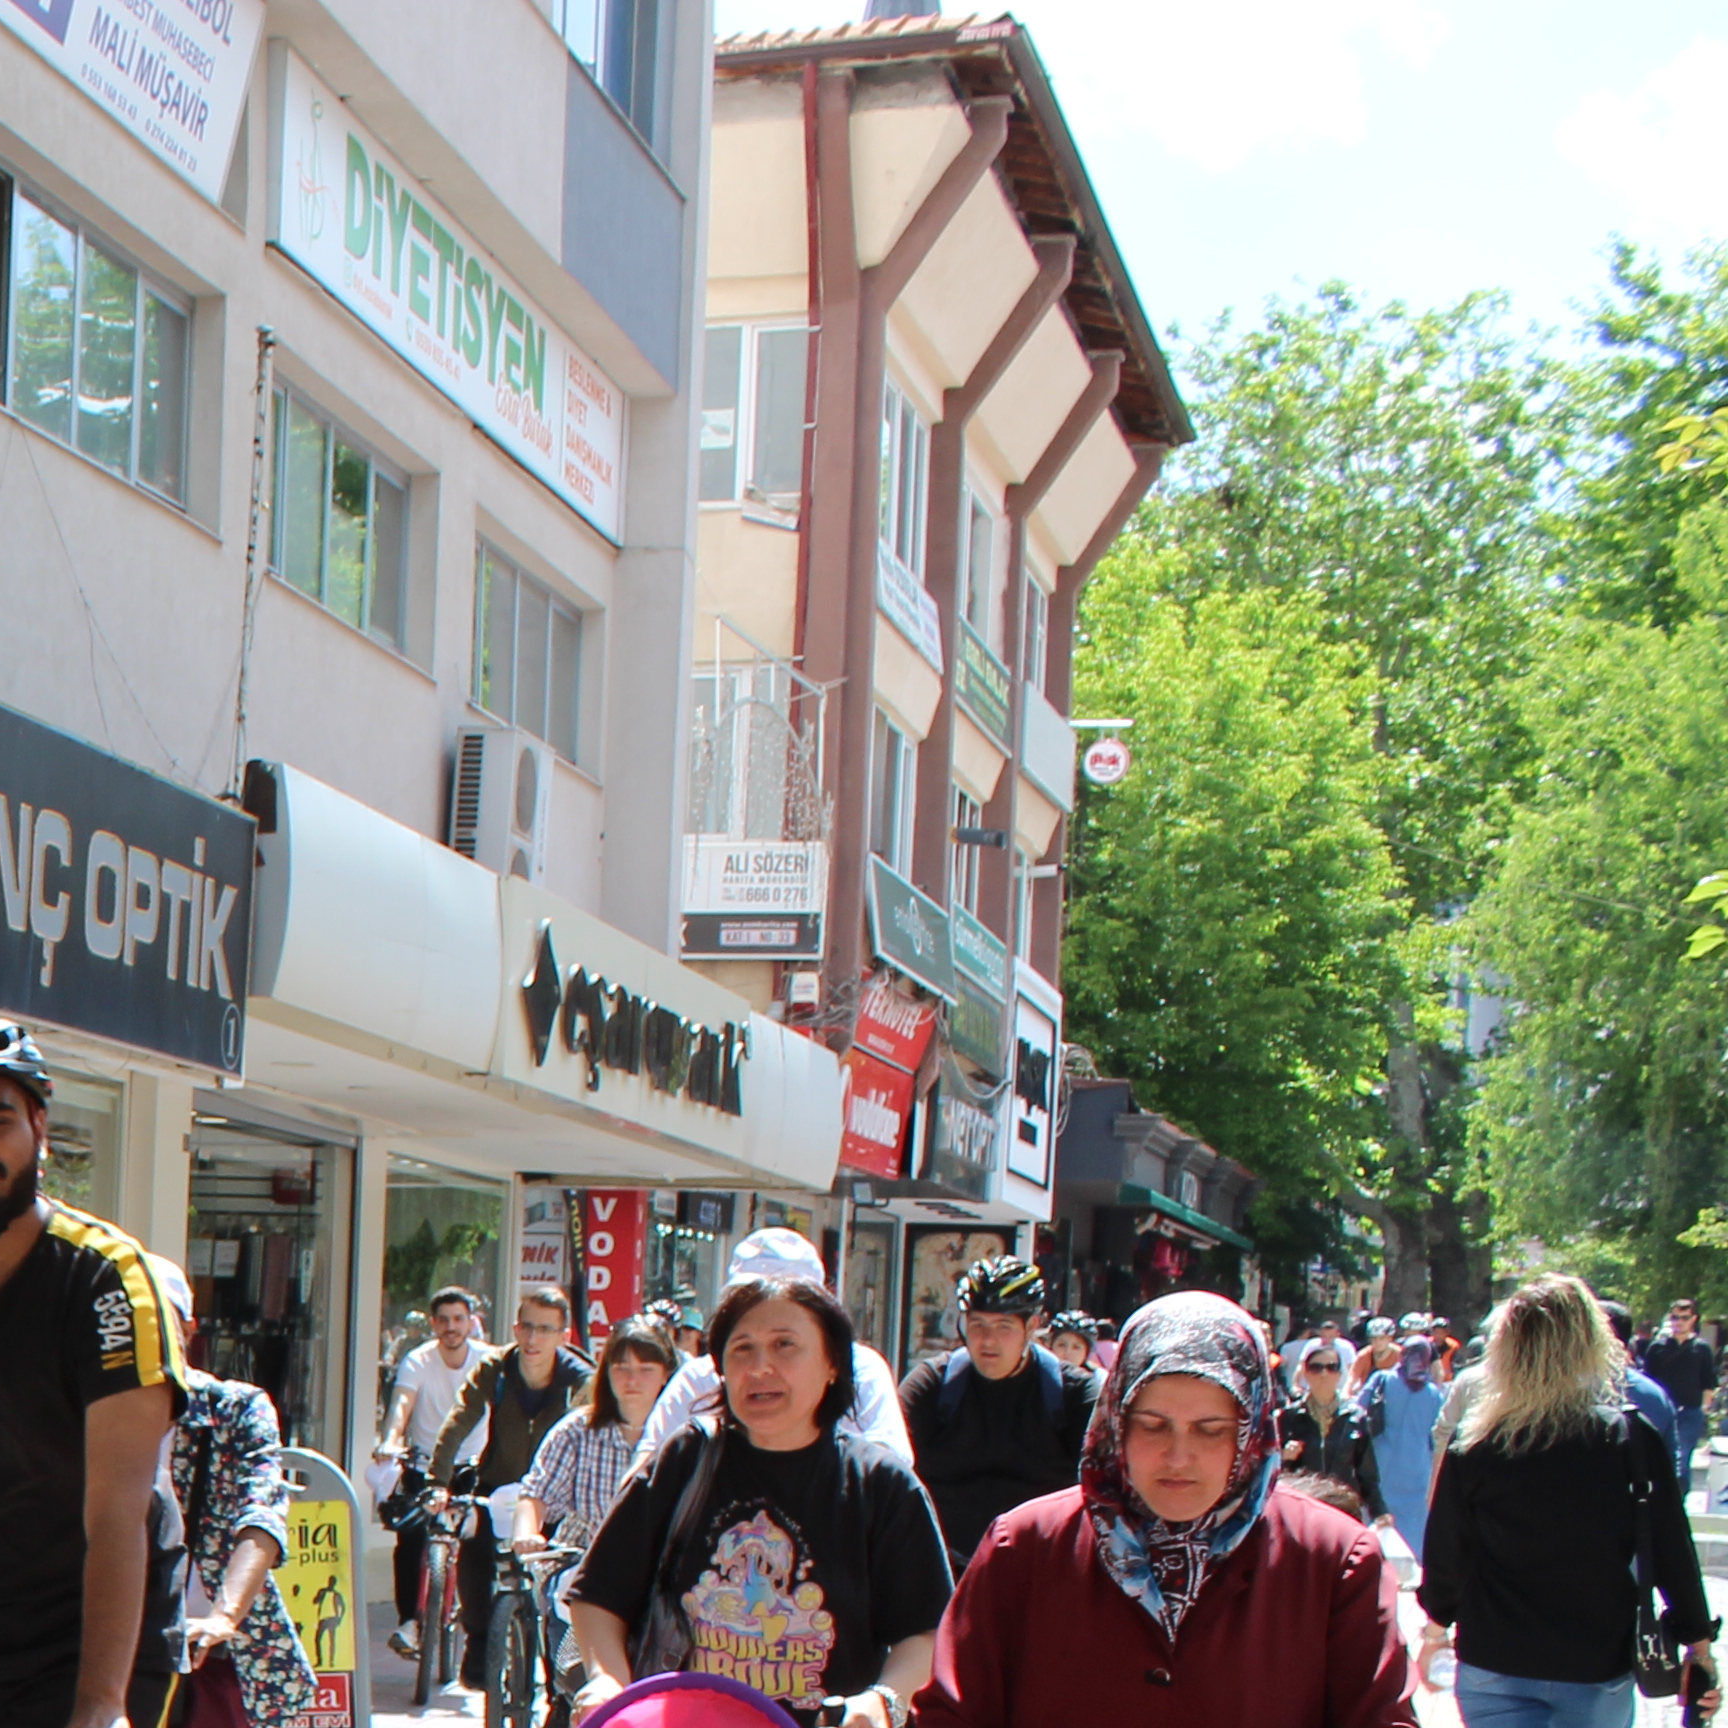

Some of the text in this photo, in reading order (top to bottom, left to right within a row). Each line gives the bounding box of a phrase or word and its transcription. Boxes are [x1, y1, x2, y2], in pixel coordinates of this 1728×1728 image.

[89, 6, 210, 142] MALİ MÜŞAVİR
[343, 131, 547, 417] DİYETİSYEN
[84, 829, 239, 1000] OPTİK
[723, 851, 749, 875] ALİ
